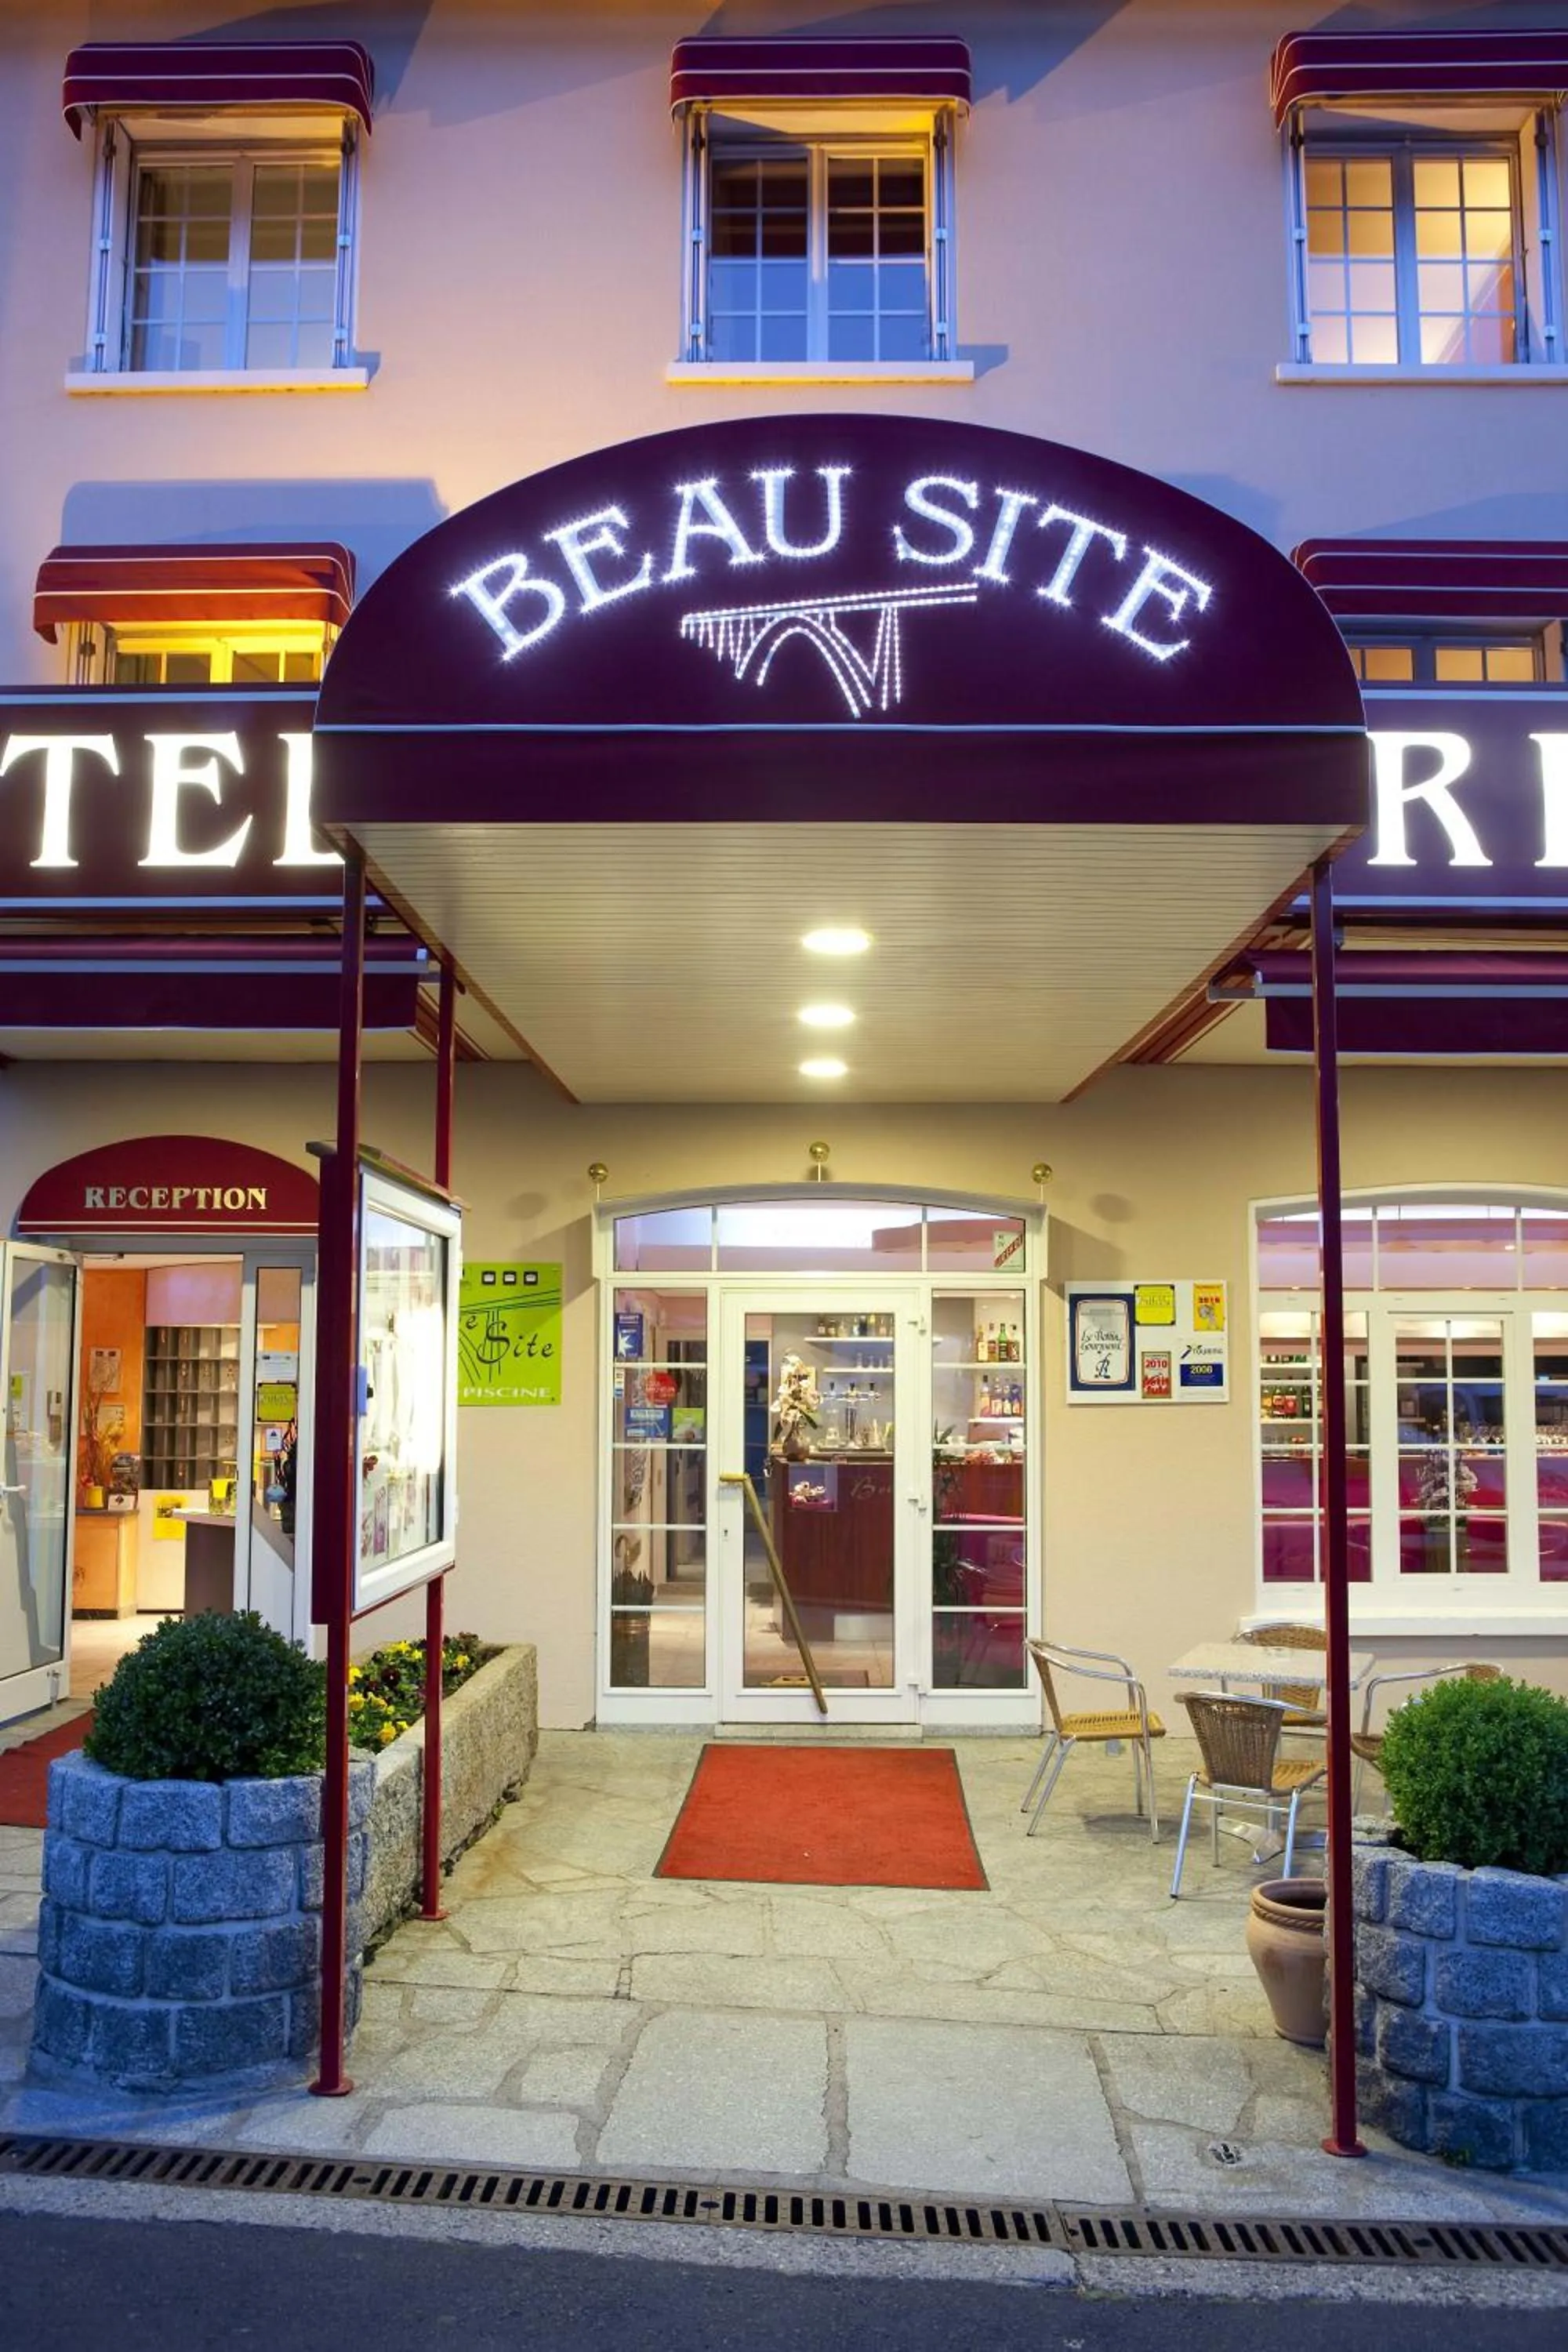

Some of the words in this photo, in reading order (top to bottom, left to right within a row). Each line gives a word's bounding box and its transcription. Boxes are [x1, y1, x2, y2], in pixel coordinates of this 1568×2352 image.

[449, 466, 852, 662] BEAU
[895, 476, 1213, 661] SITE
[84, 1186, 268, 1210] RECEPTION
[476, 1321, 554, 1363] Site
[1145, 1359, 1168, 1368] 2010
[463, 1387, 550, 1399] PISCINE
